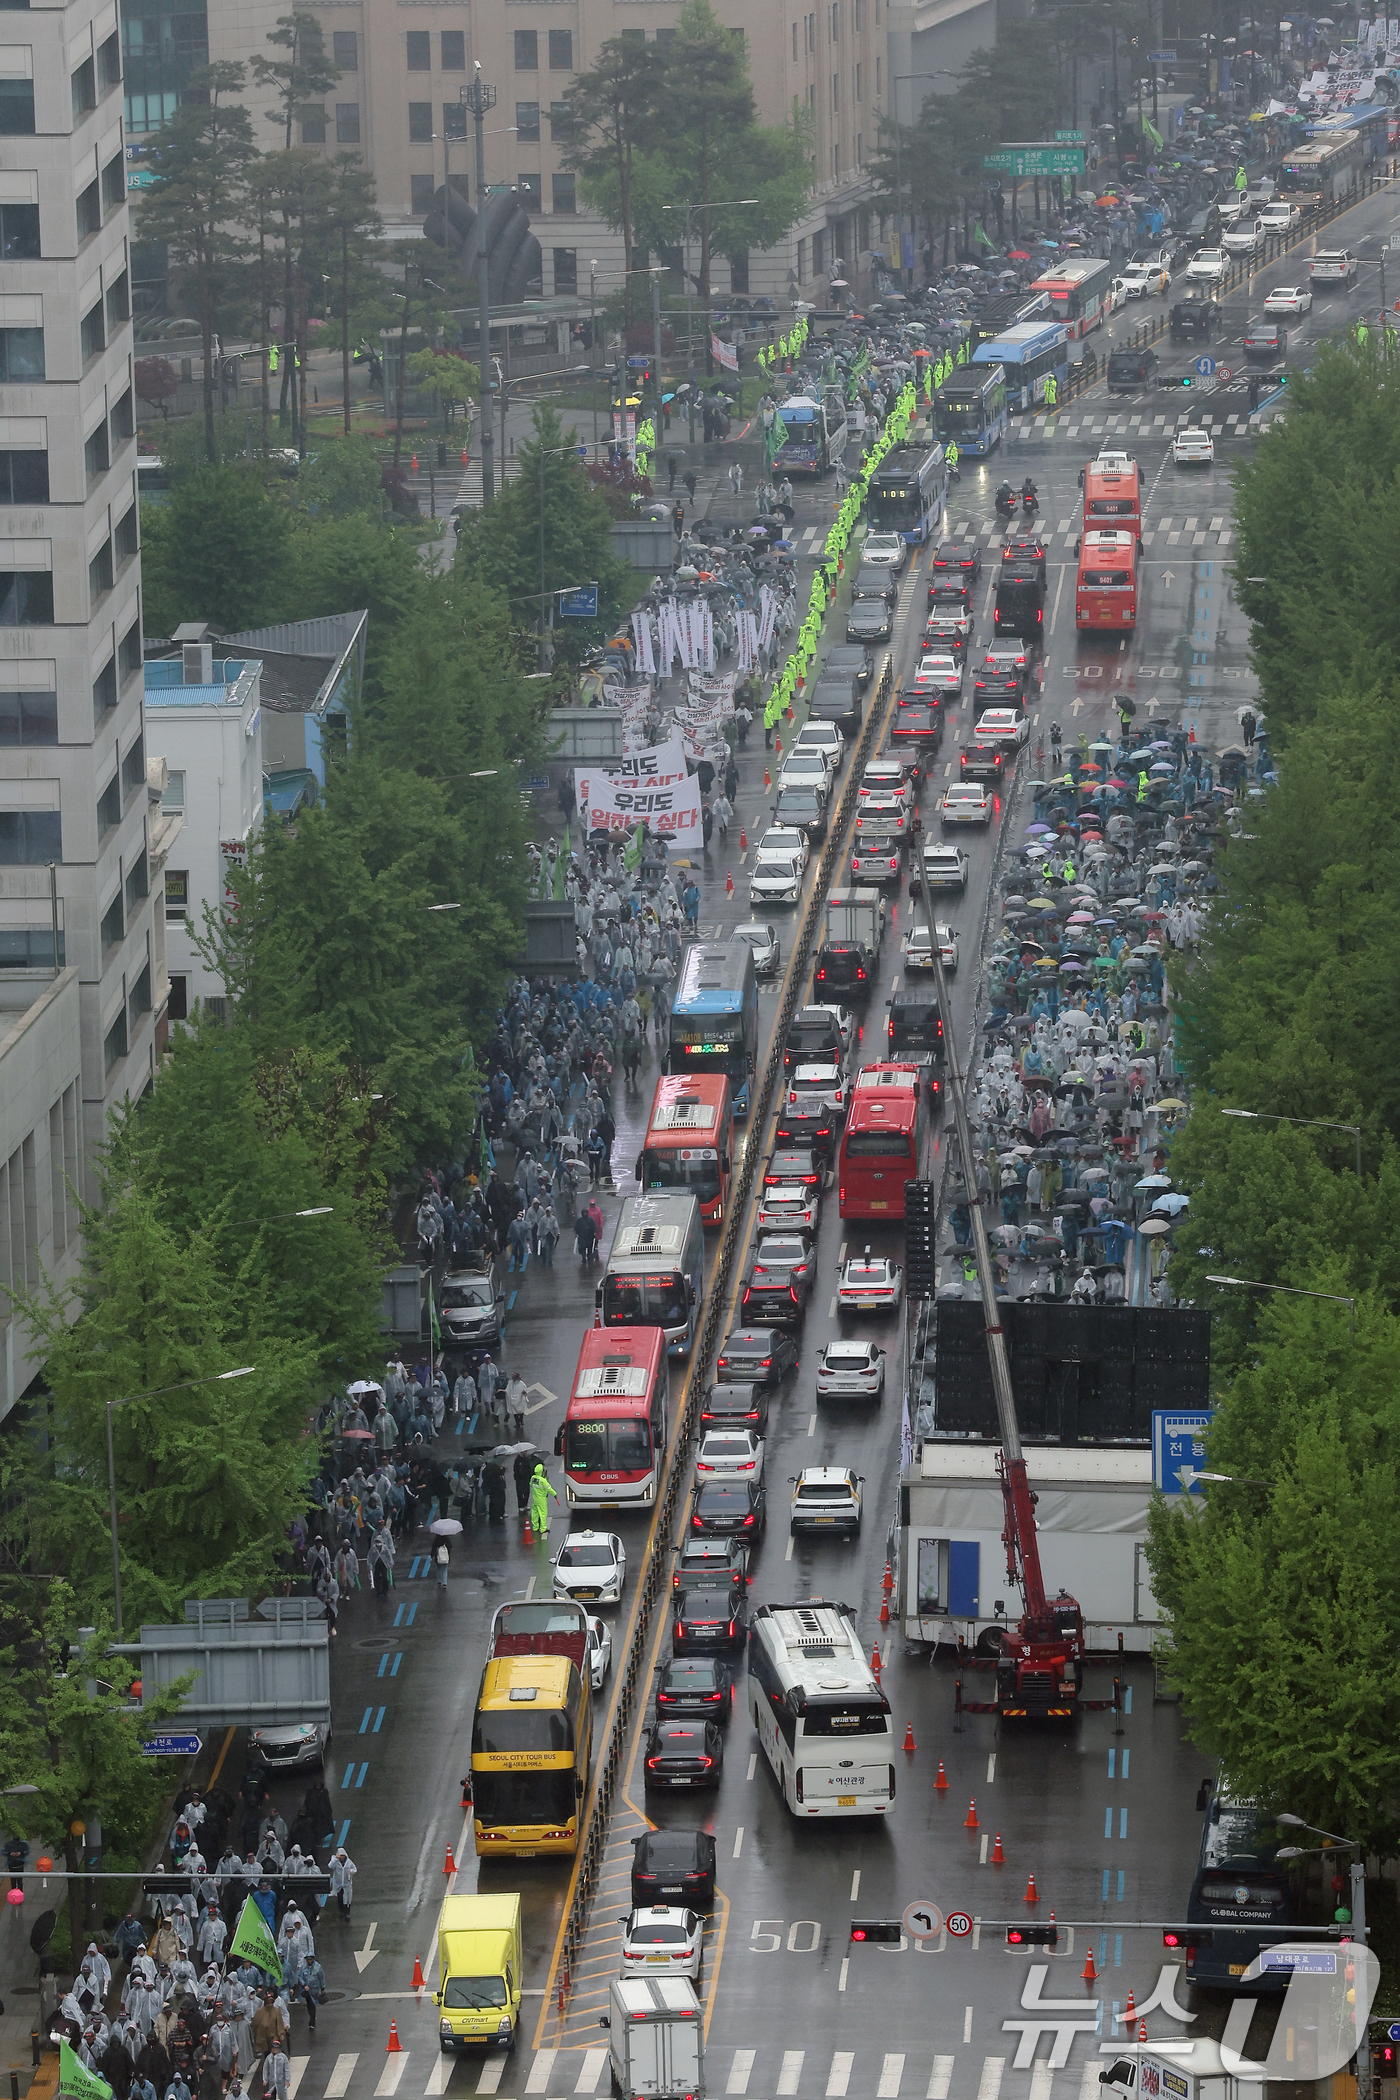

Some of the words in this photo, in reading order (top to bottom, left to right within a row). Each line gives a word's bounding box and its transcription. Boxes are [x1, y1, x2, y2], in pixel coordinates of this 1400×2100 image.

[1062, 666, 1103, 678] 50
[1137, 666, 1179, 678] 50
[614, 792, 674, 812] 우리도
[591, 808, 651, 830] 일하고
[657, 808, 698, 831] 싶다
[577, 1423, 605, 1433] 8800
[1021, 1645, 1031, 1656] 형
[1210, 1908, 1238, 1917] GLOBAL
[1239, 1910, 1271, 1919] COMPANY
[952, 1918, 967, 1931] 50
[748, 1919, 822, 1953] 50
[1276, 1955, 1310, 1964] 남대문로
